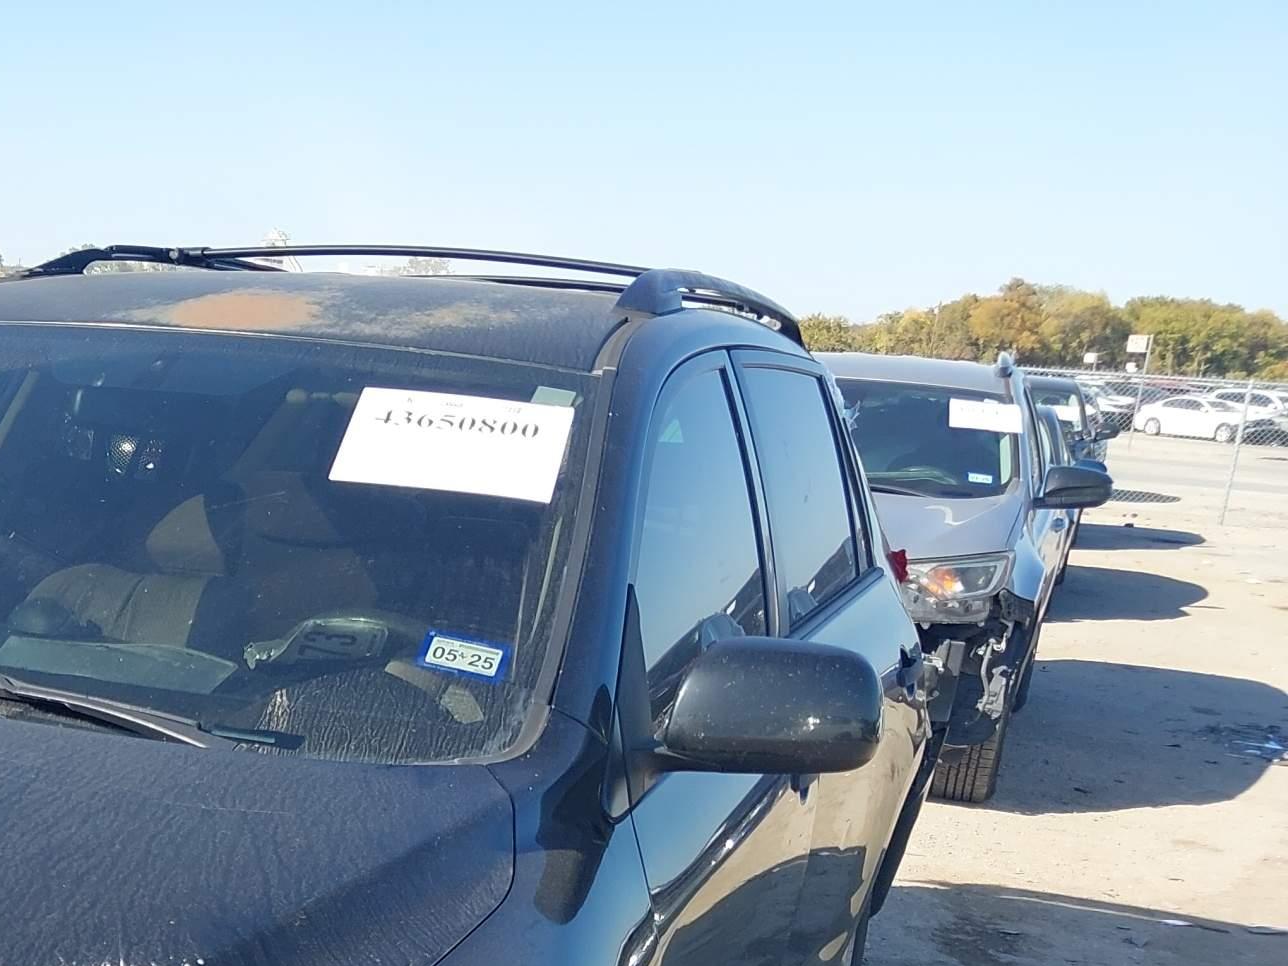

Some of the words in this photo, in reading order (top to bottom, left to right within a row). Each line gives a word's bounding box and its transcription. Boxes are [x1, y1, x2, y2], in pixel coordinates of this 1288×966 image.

[374, 409, 540, 439] 43650800
[432, 646, 459, 662] 05
[467, 653, 496, 670] 25
